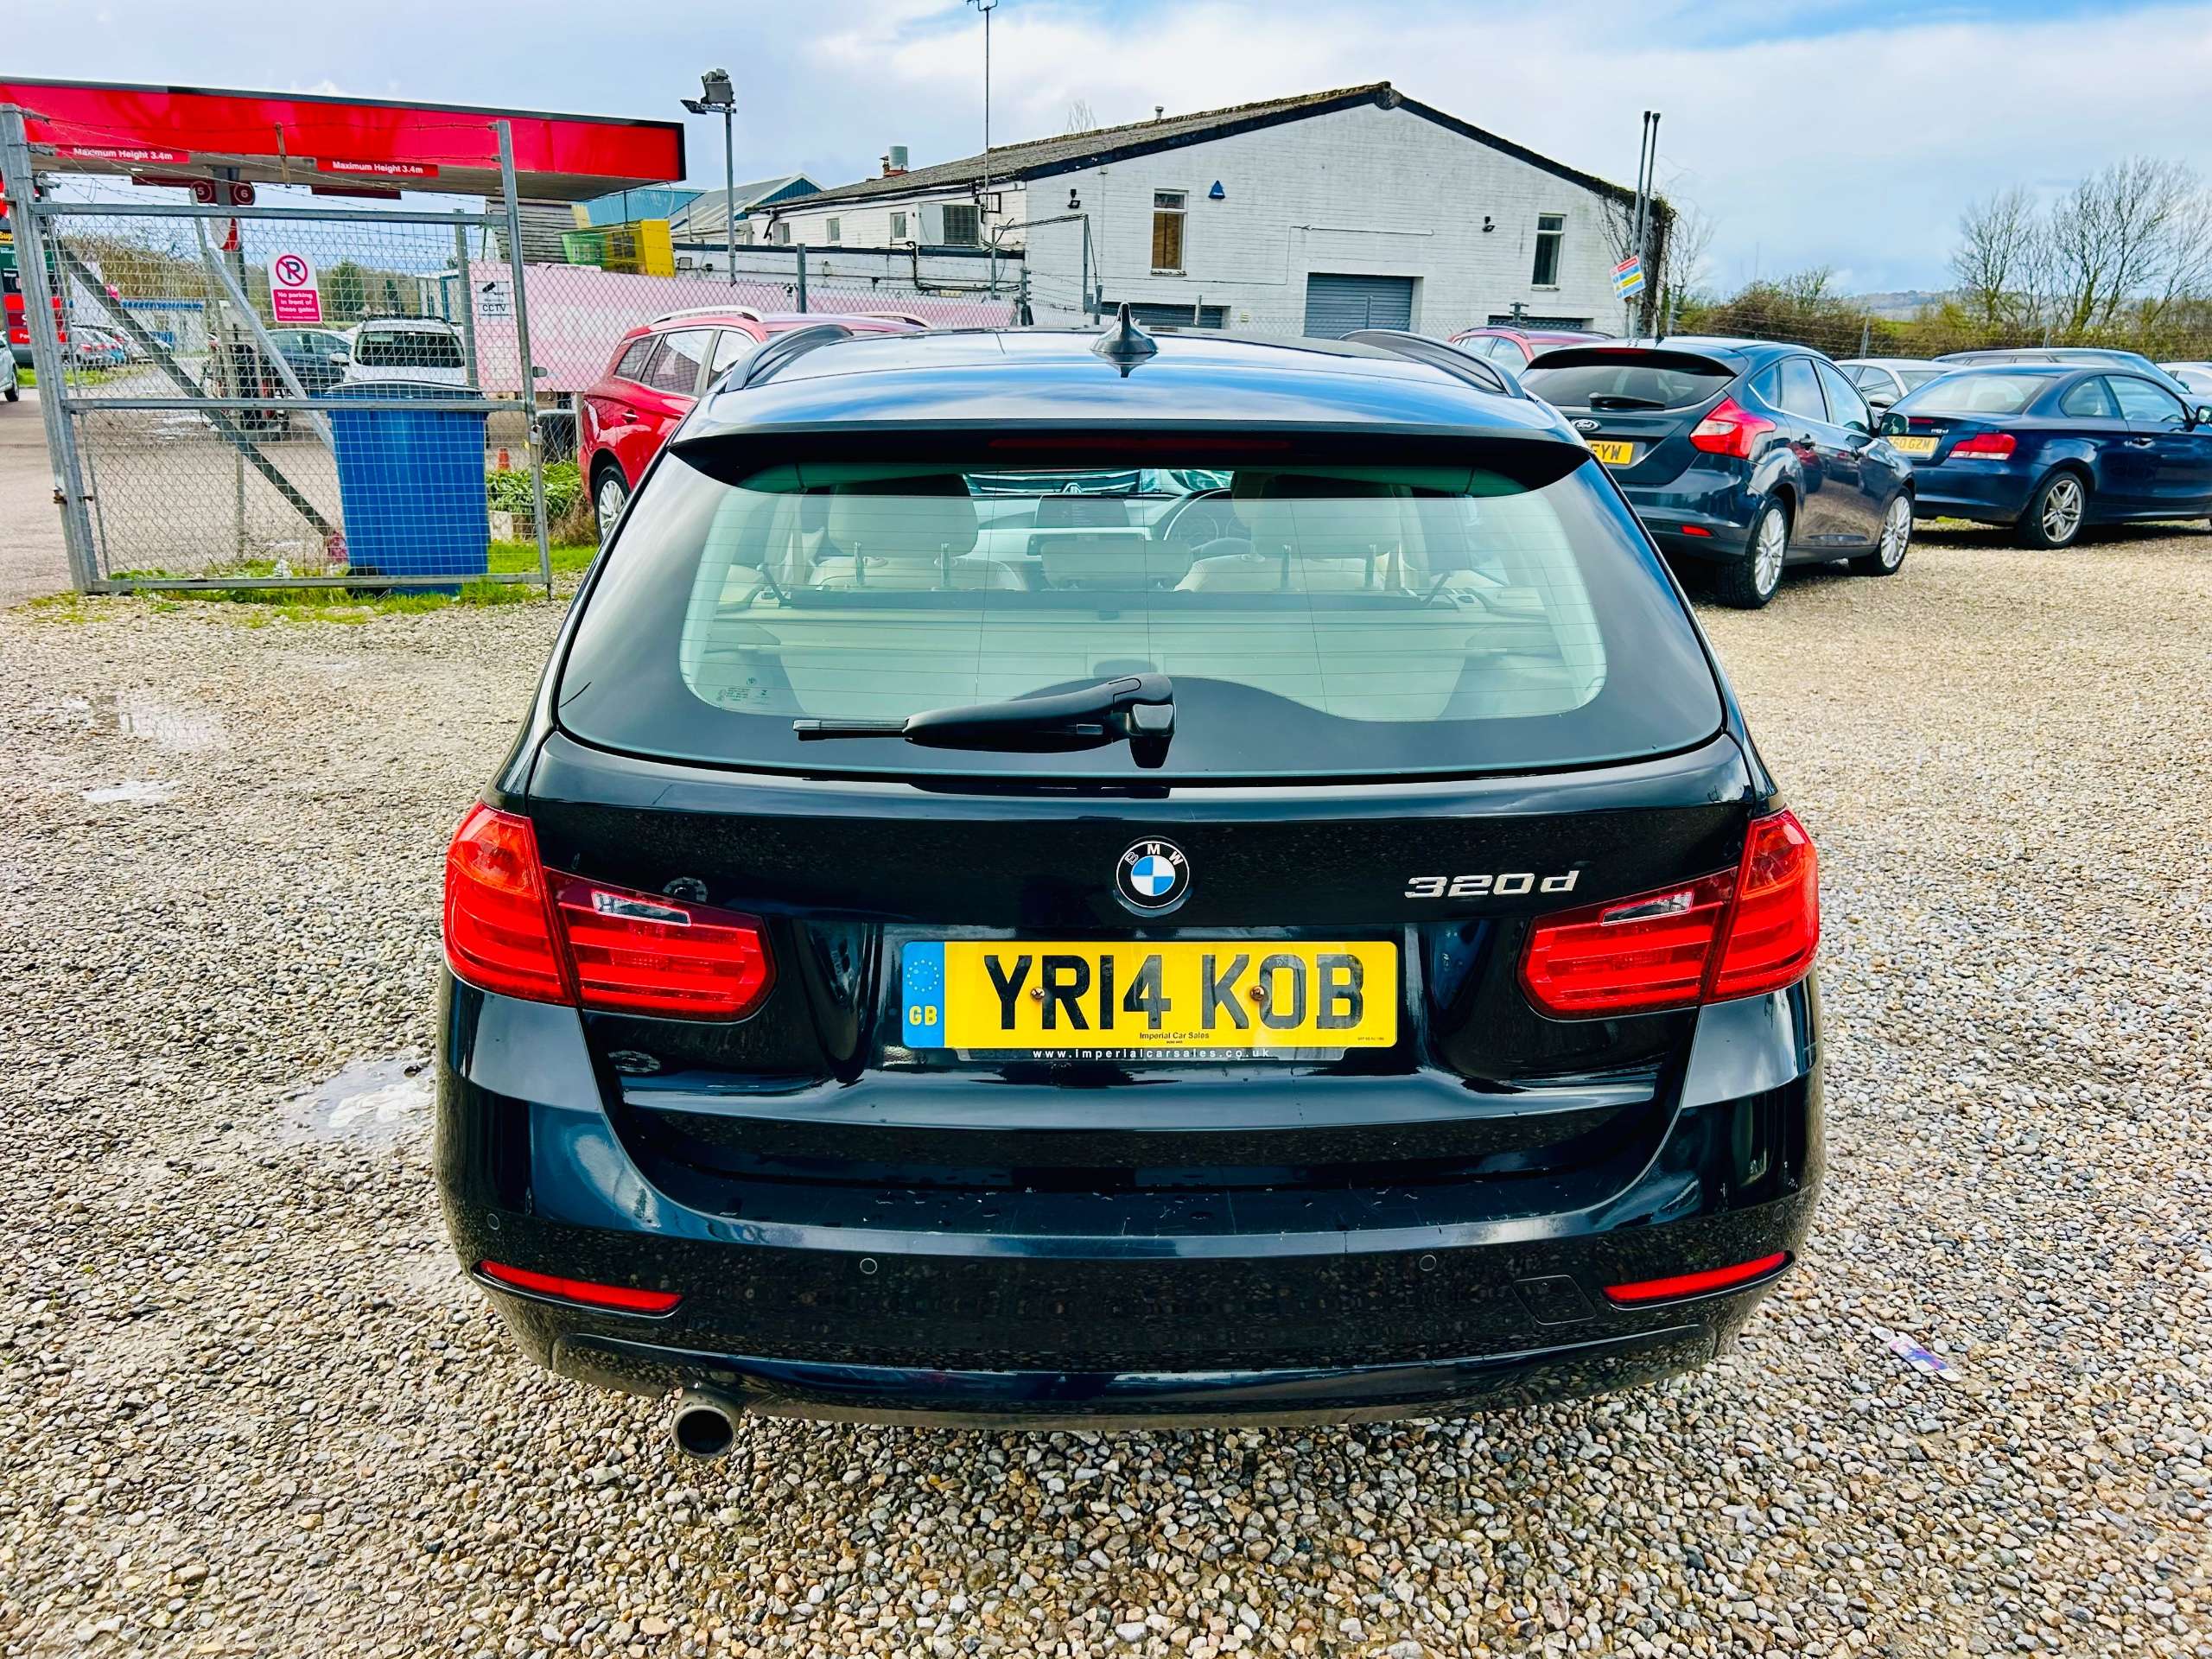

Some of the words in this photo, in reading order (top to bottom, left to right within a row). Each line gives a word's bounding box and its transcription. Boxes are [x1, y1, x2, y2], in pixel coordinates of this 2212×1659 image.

[73, 148, 117, 157] Maximum
[118, 150, 149, 161] Height
[150, 151, 174, 161] 3.4m
[332, 161, 372, 171] Maximum
[373, 164, 402, 175] Height
[402, 165, 423, 175] 3.4m
[240, 189, 250, 199] 6
[482, 303, 506, 312] CCTV
[1124, 843, 1184, 866] BMW
[1404, 870, 1580, 899] 320d
[983, 954, 1172, 1031] YR14
[1201, 954, 1364, 1031] KOB
[908, 1005, 938, 1027] GB
[1139, 1032, 1171, 1040] Imperial
[1033, 1048, 1270, 1061] www.imperialcarsales.co.uk
